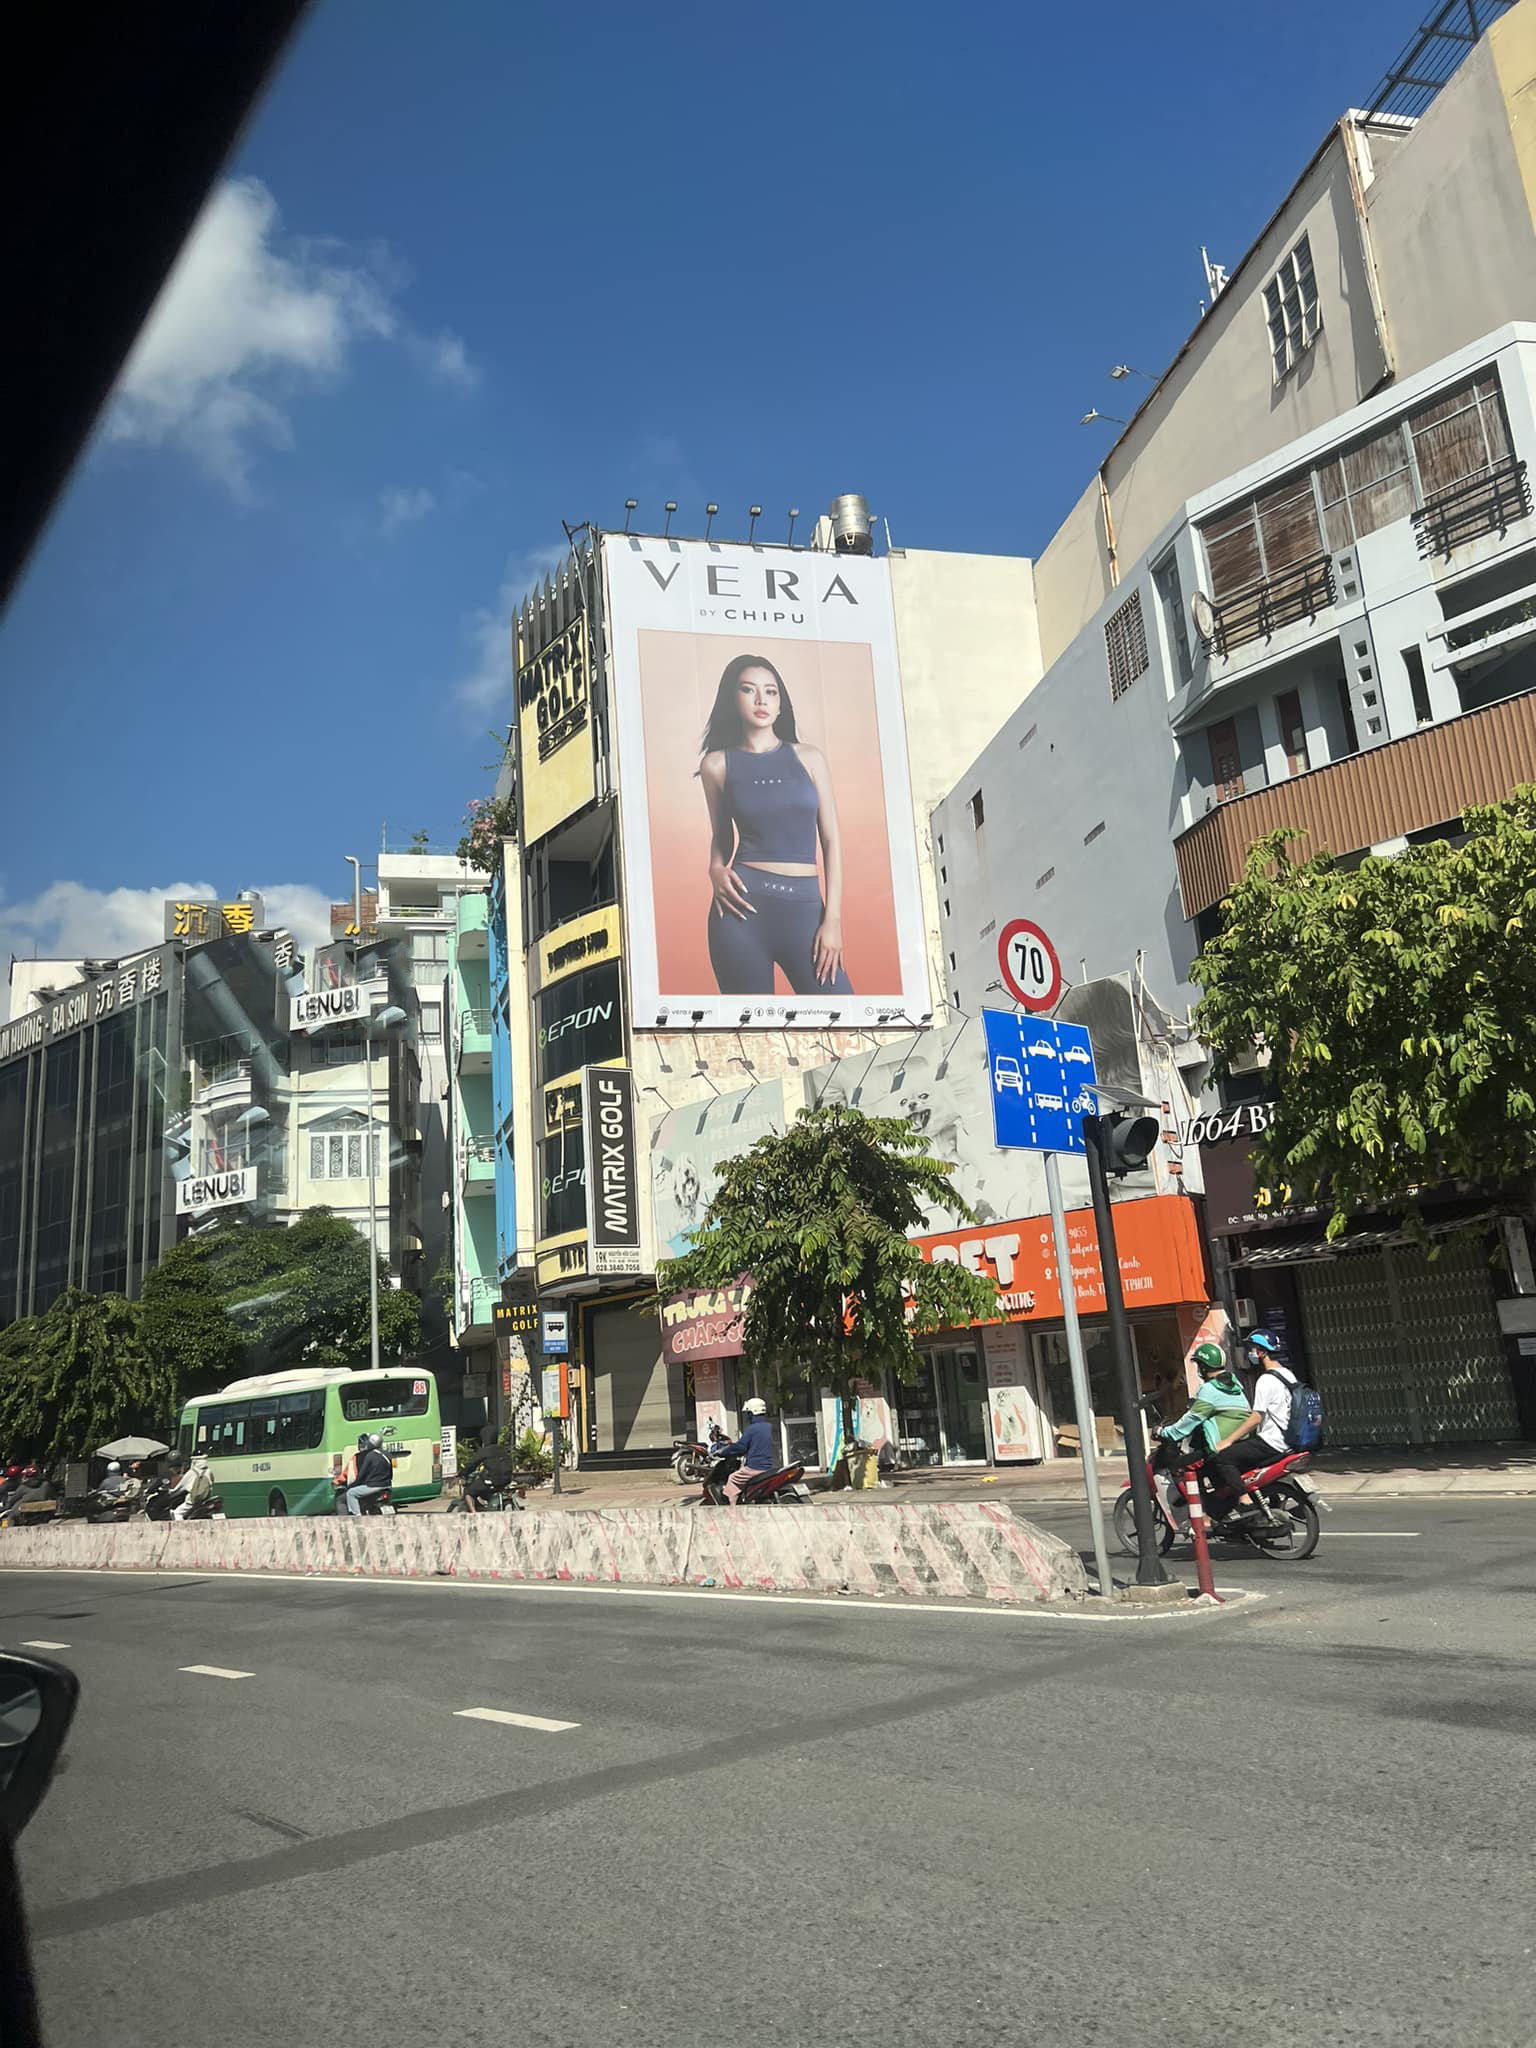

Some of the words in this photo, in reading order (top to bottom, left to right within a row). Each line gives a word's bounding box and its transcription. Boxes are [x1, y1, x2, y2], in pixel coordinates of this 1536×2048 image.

[643, 560, 858, 605] VERA
[700, 608, 716, 618] BY
[724, 608, 804, 624] CHIPU
[520, 625, 581, 712] MATRIX
[537, 664, 583, 733] GOLF
[764, 882, 793, 893] VERA
[1015, 942, 1045, 985] 70
[52, 1003, 65, 1035] BA
[68, 992, 90, 1028] SON
[548, 1001, 613, 1043] EPON
[598, 1078, 624, 1140] GOLF
[600, 1143, 629, 1236] MATRIX
[595, 1251, 608, 1264] 19K
[496, 1303, 538, 1319] MATRIX
[512, 1318, 539, 1332] GOLF
[350, 1401, 366, 1417] 88
[415, 1382, 425, 1394] 88
